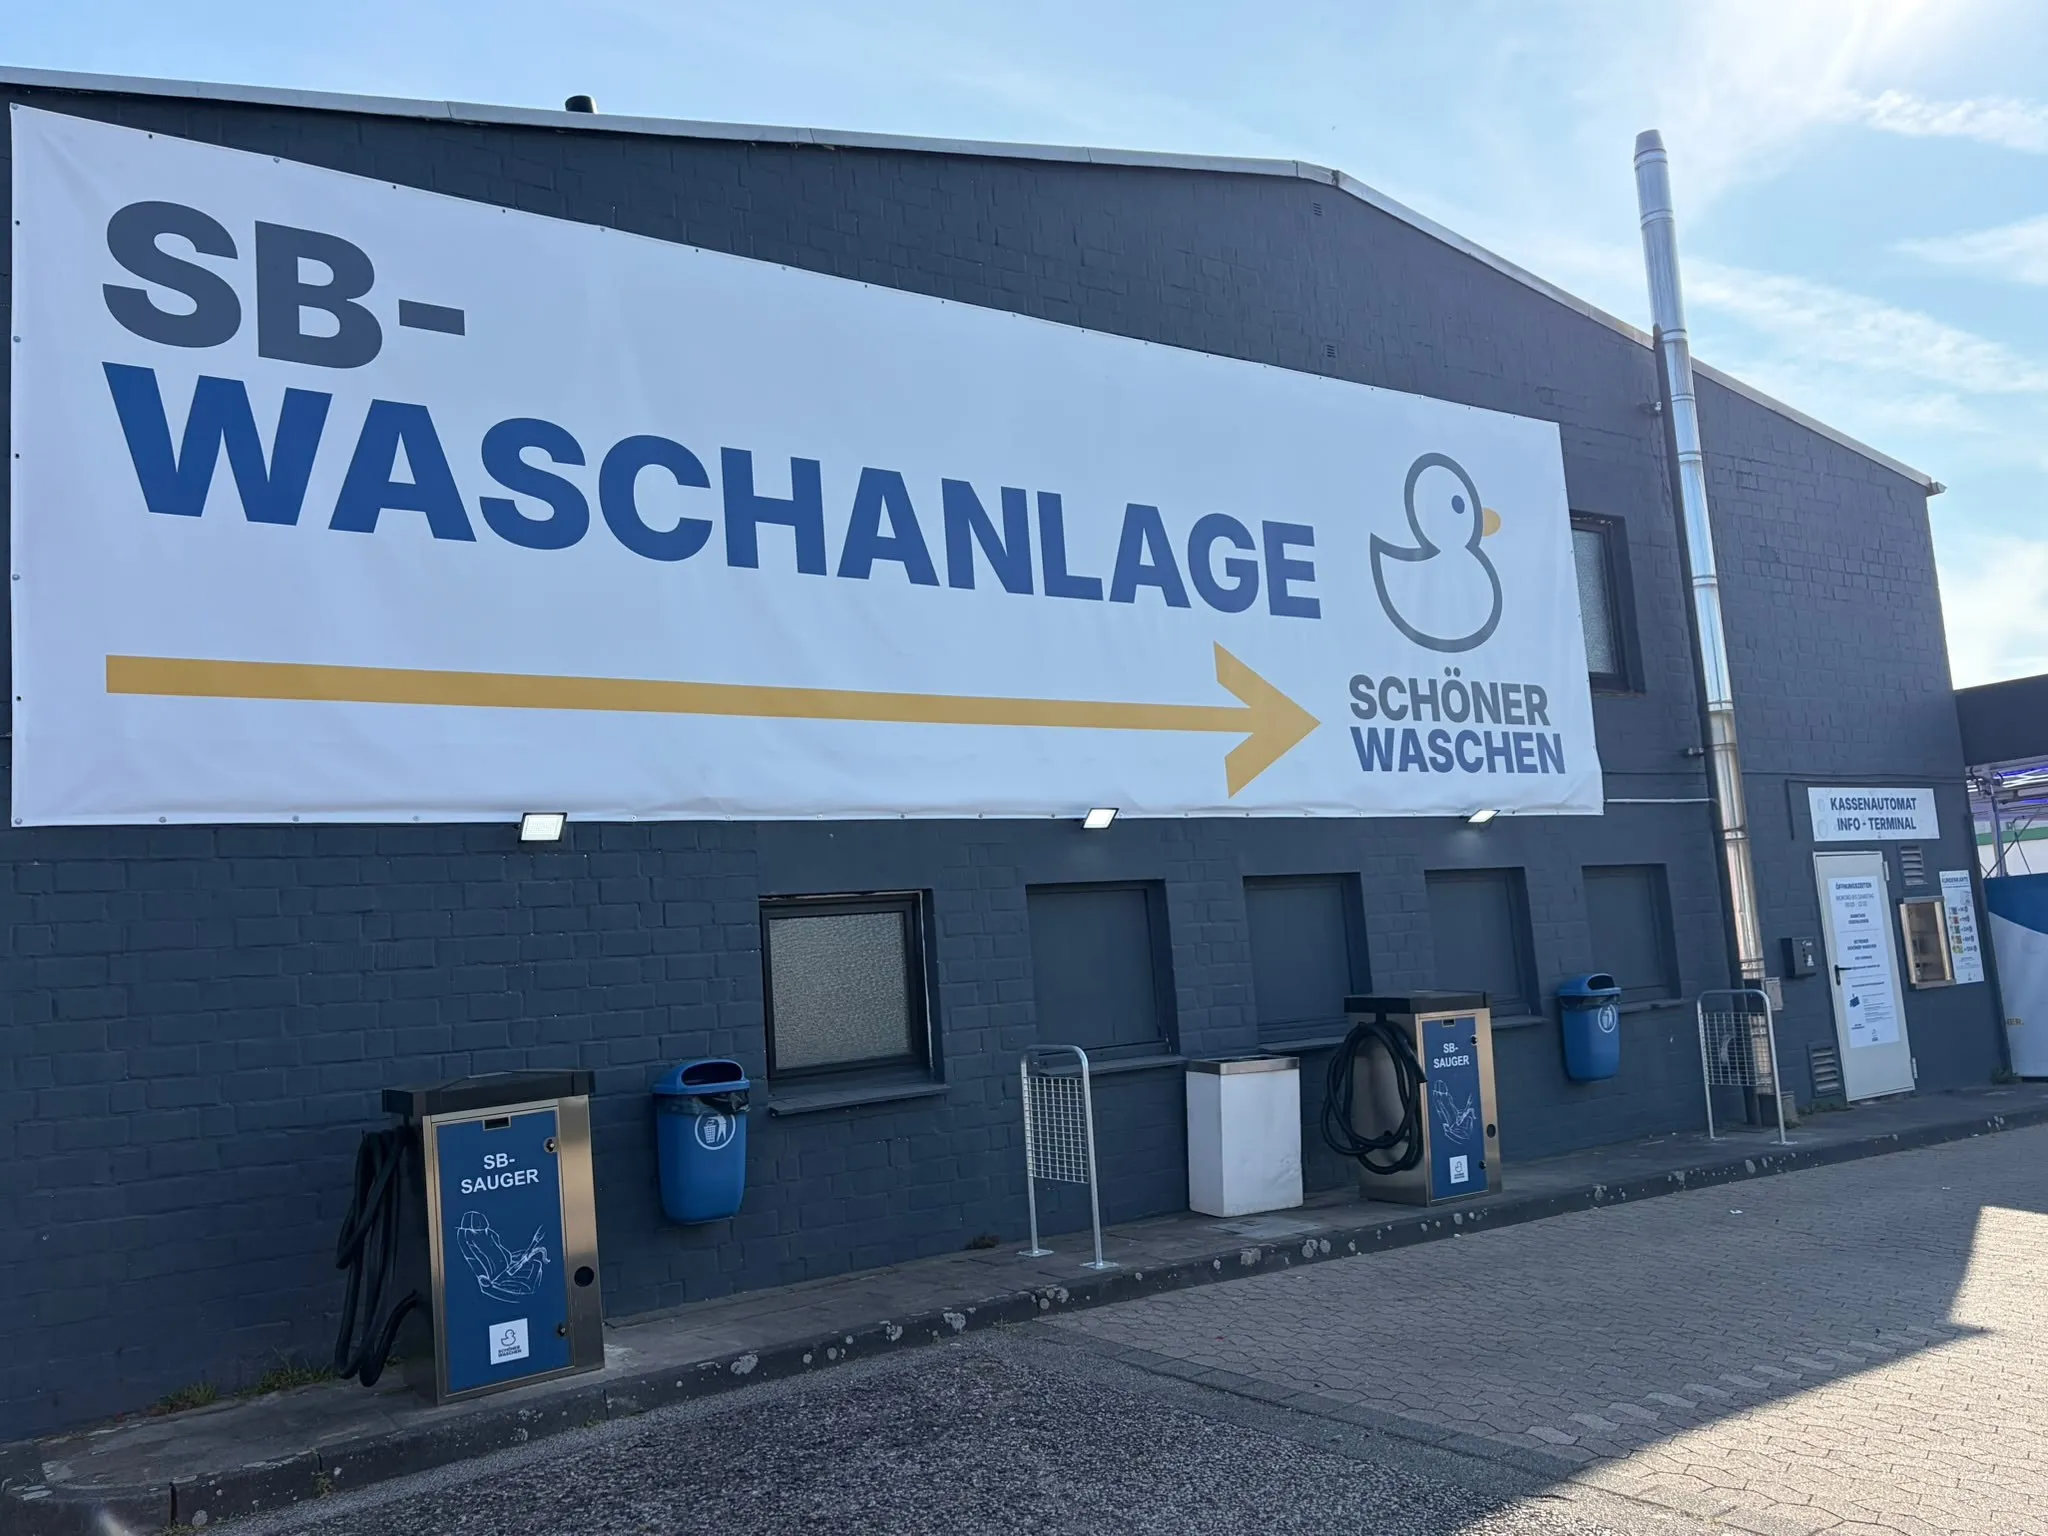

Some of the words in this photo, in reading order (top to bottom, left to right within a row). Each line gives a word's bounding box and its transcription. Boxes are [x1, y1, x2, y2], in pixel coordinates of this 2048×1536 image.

[102, 200, 466, 369] SB-
[101, 361, 1322, 620] WASCHANLAGE
[1349, 666, 1551, 726] SCHÖNER
[1349, 726, 1566, 774] WASCHEN
[1829, 797, 1917, 811] KASSENAUTOMAT
[1836, 817, 1861, 831] INFO
[1867, 816, 1917, 830] TERMINAL
[1443, 1042, 1459, 1053] SB-
[1433, 1055, 1470, 1068] SAUGER
[483, 1152, 516, 1170] SB-
[460, 1168, 540, 1194] SAUGER
